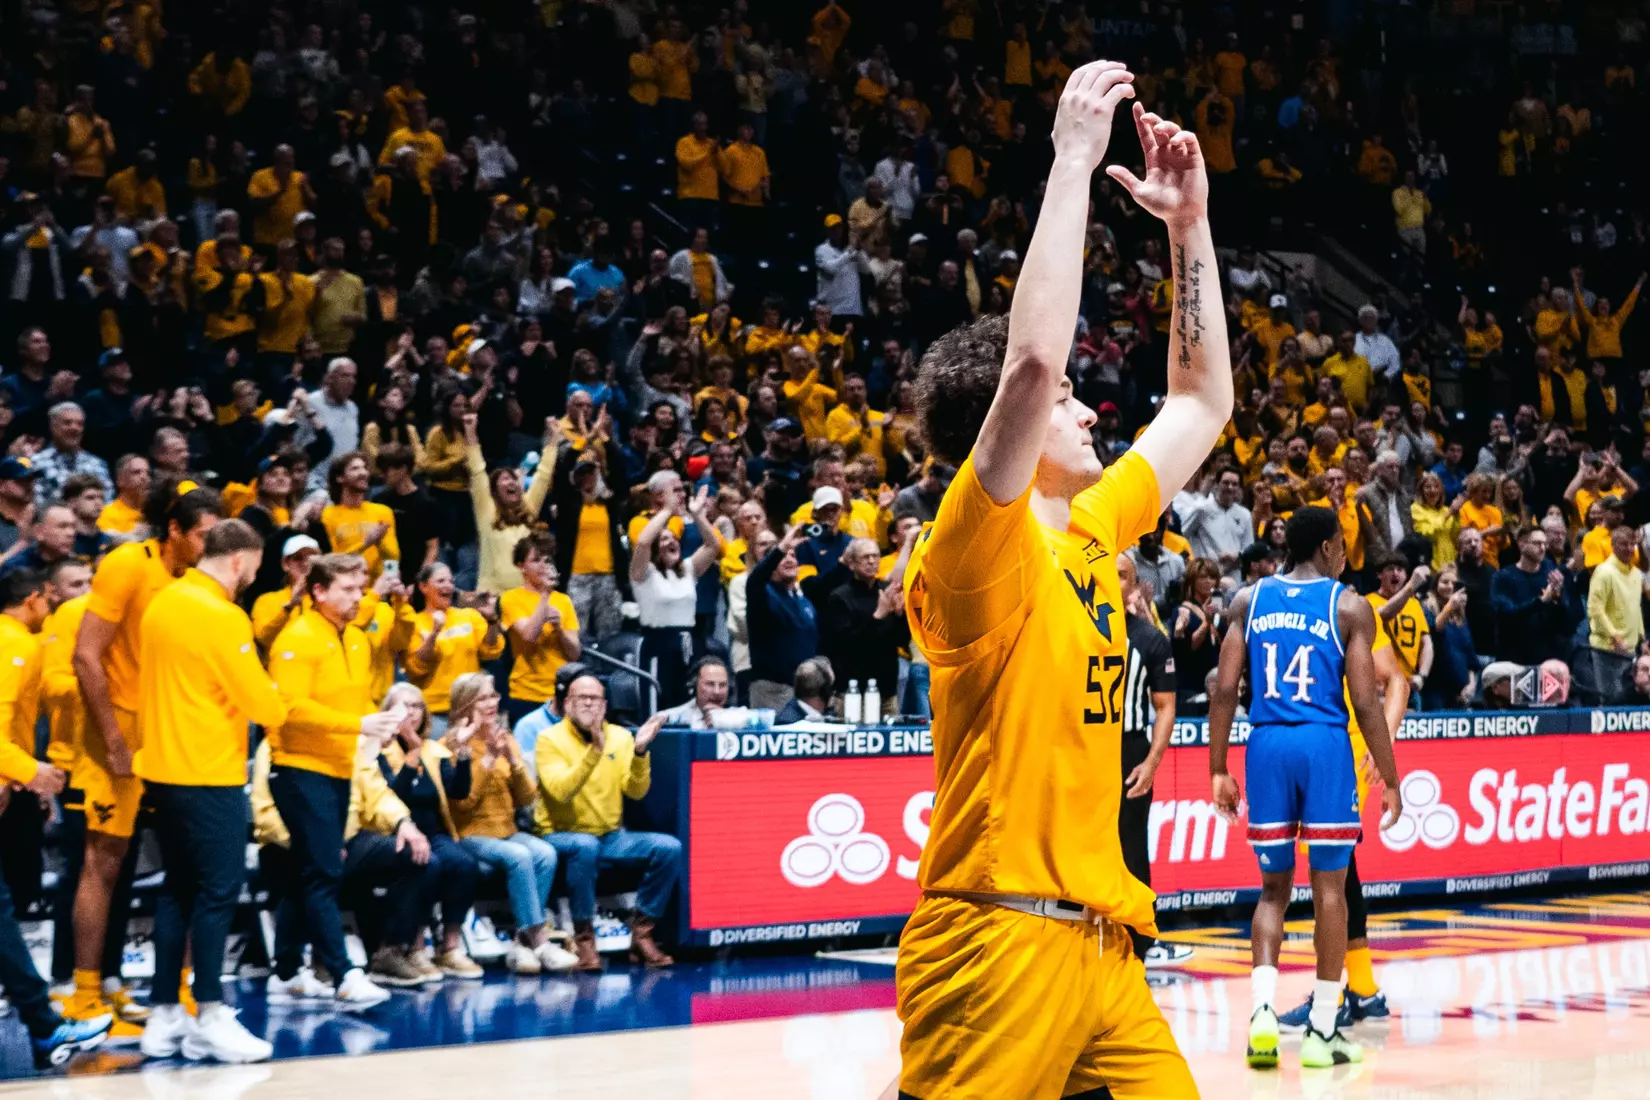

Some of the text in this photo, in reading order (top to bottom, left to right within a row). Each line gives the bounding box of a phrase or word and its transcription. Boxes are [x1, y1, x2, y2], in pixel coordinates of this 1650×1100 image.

[1251, 612, 1307, 634] COUNCIL
[1262, 642, 1316, 703] 14
[1084, 655, 1125, 724] 52
[1396, 715, 1539, 739] ERSIFIED ENERGY
[741, 732, 884, 757] DIVERSIFIED
[889, 731, 934, 753] ENE
[1148, 799, 1229, 864] rm
[1361, 882, 1402, 898] ENERGY
[1456, 873, 1512, 892] DIVERSIFIED
[1513, 870, 1549, 887] ENERGY
[1156, 891, 1237, 911] SIFIED ENERGY
[725, 924, 806, 943] DIVERSIFIED
[808, 920, 860, 937] ENERGY
